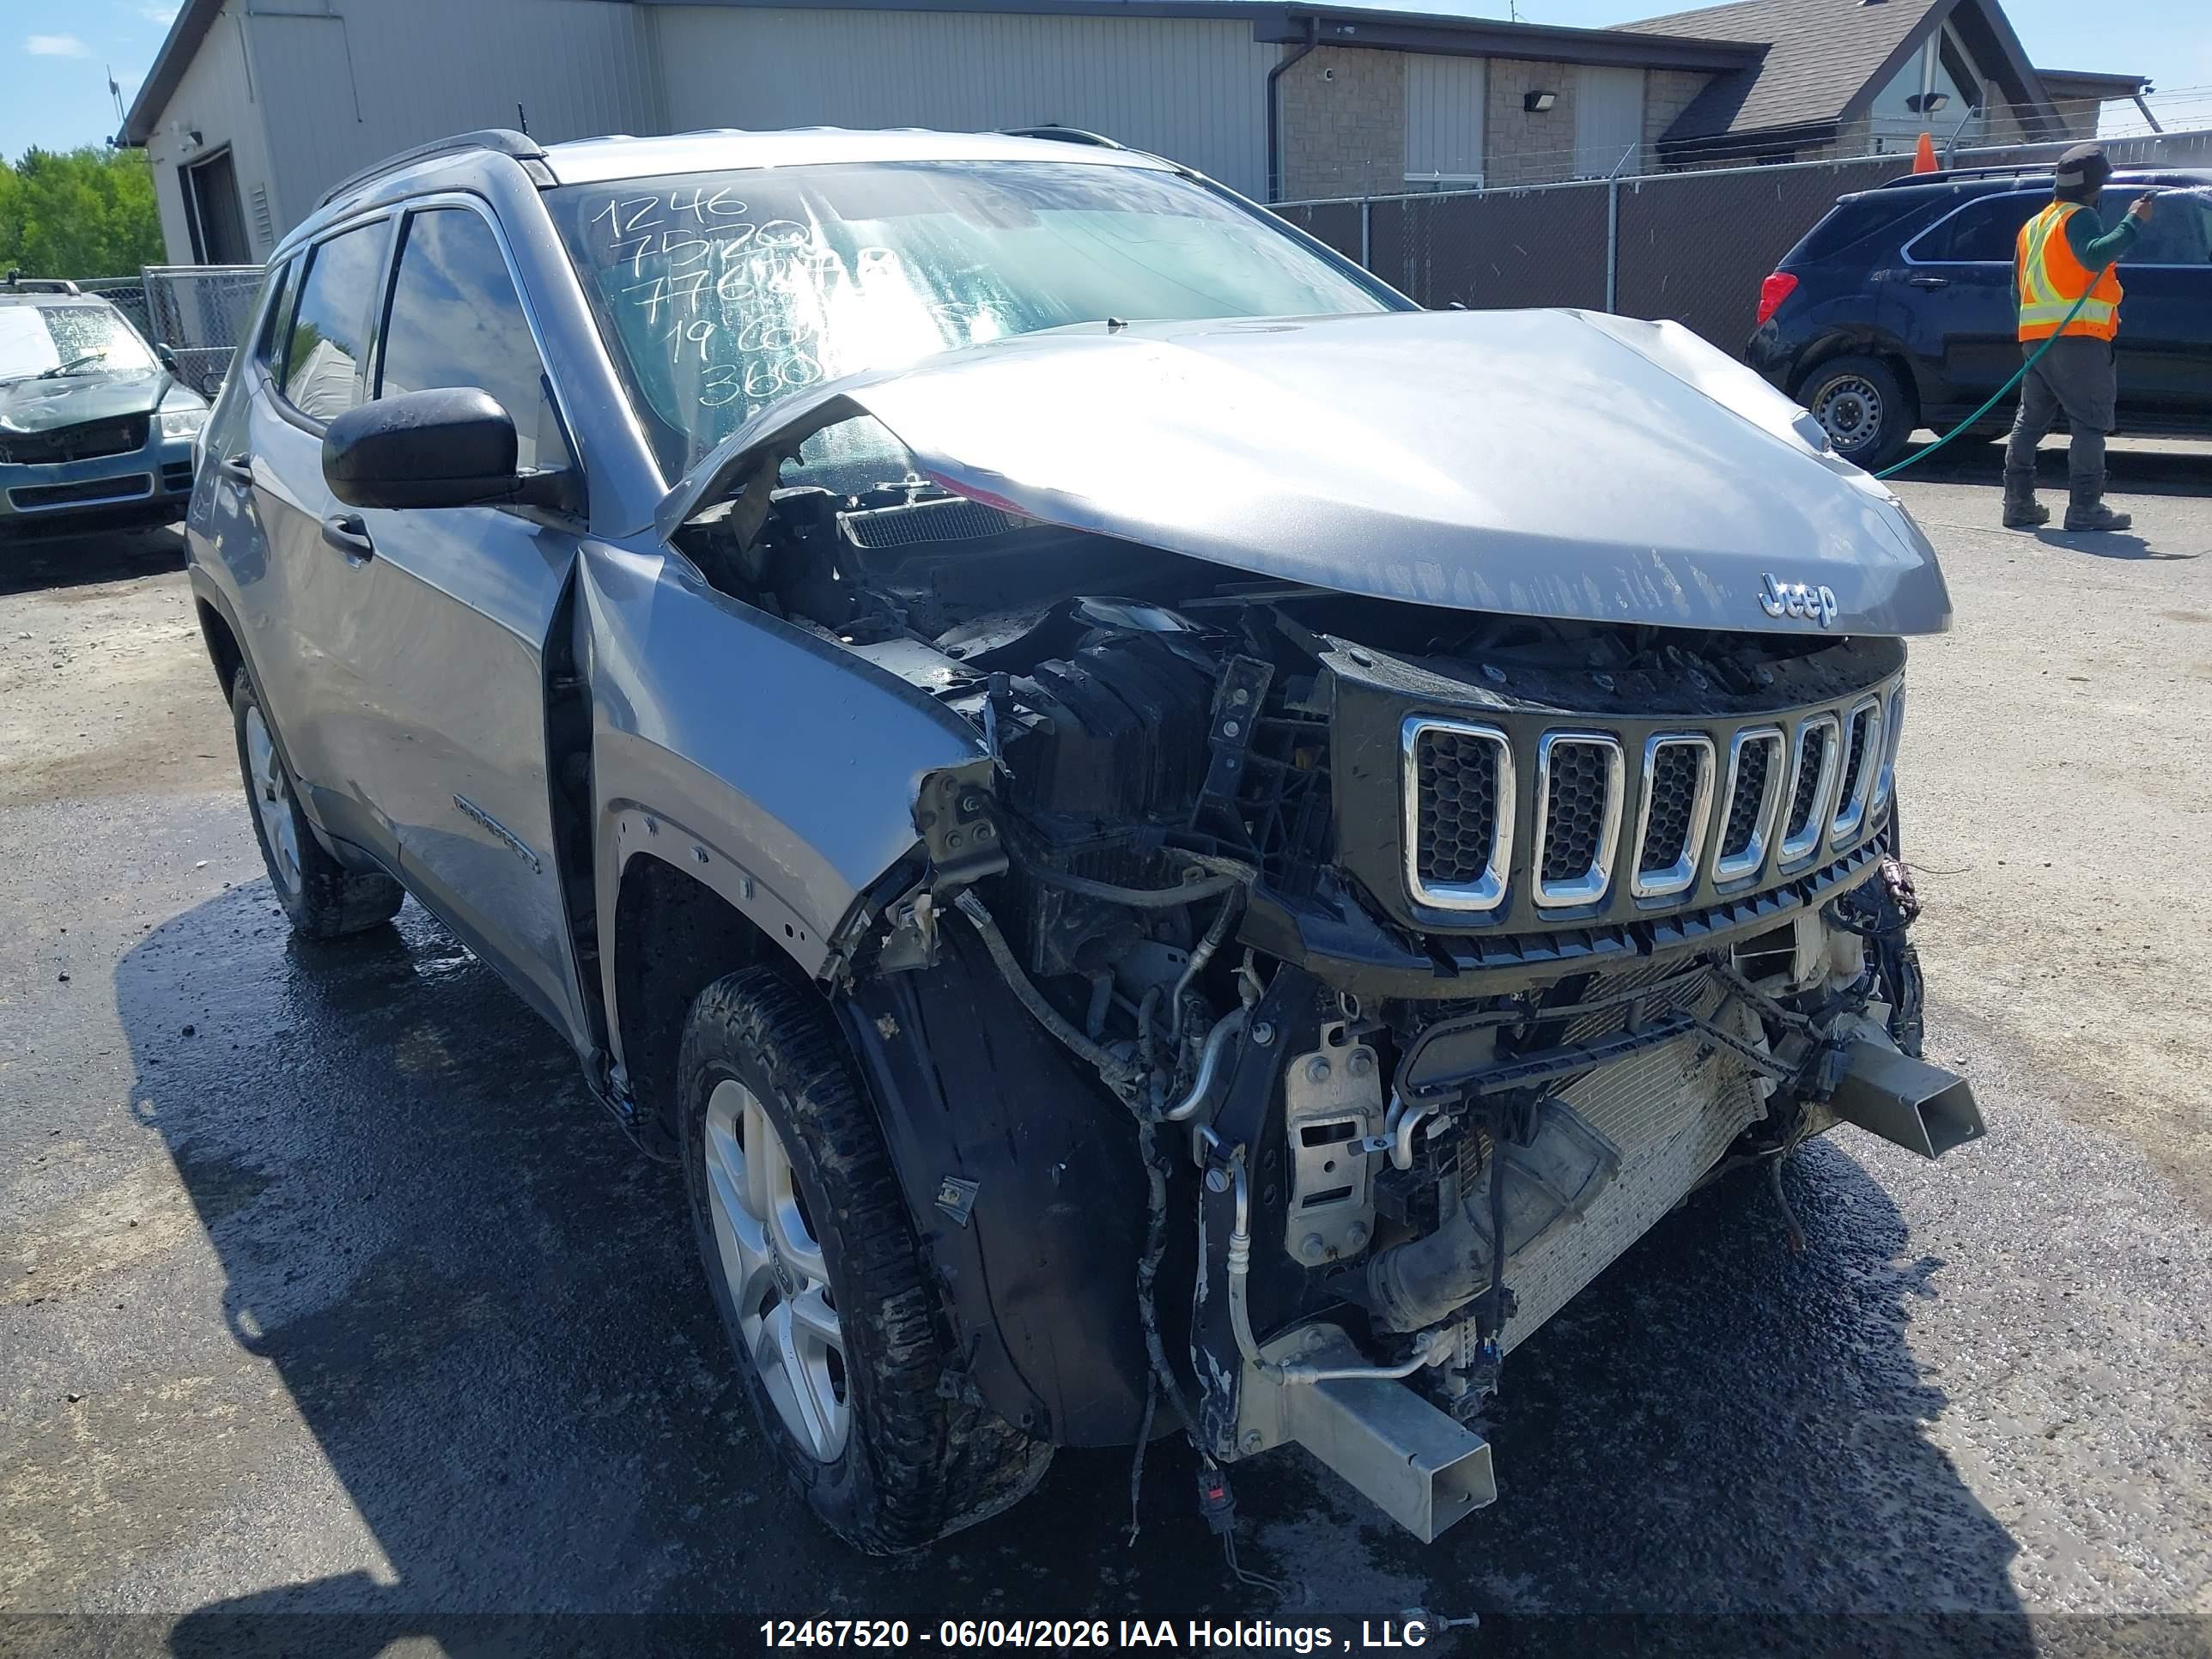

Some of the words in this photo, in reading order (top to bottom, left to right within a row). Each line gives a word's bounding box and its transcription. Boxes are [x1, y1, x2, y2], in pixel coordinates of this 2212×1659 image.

[591, 186, 749, 239] 1246
[611, 219, 811, 277] 7520
[664, 319, 717, 364] 19
[699, 355, 824, 406] 360
[1759, 572, 1838, 629] Jeep
